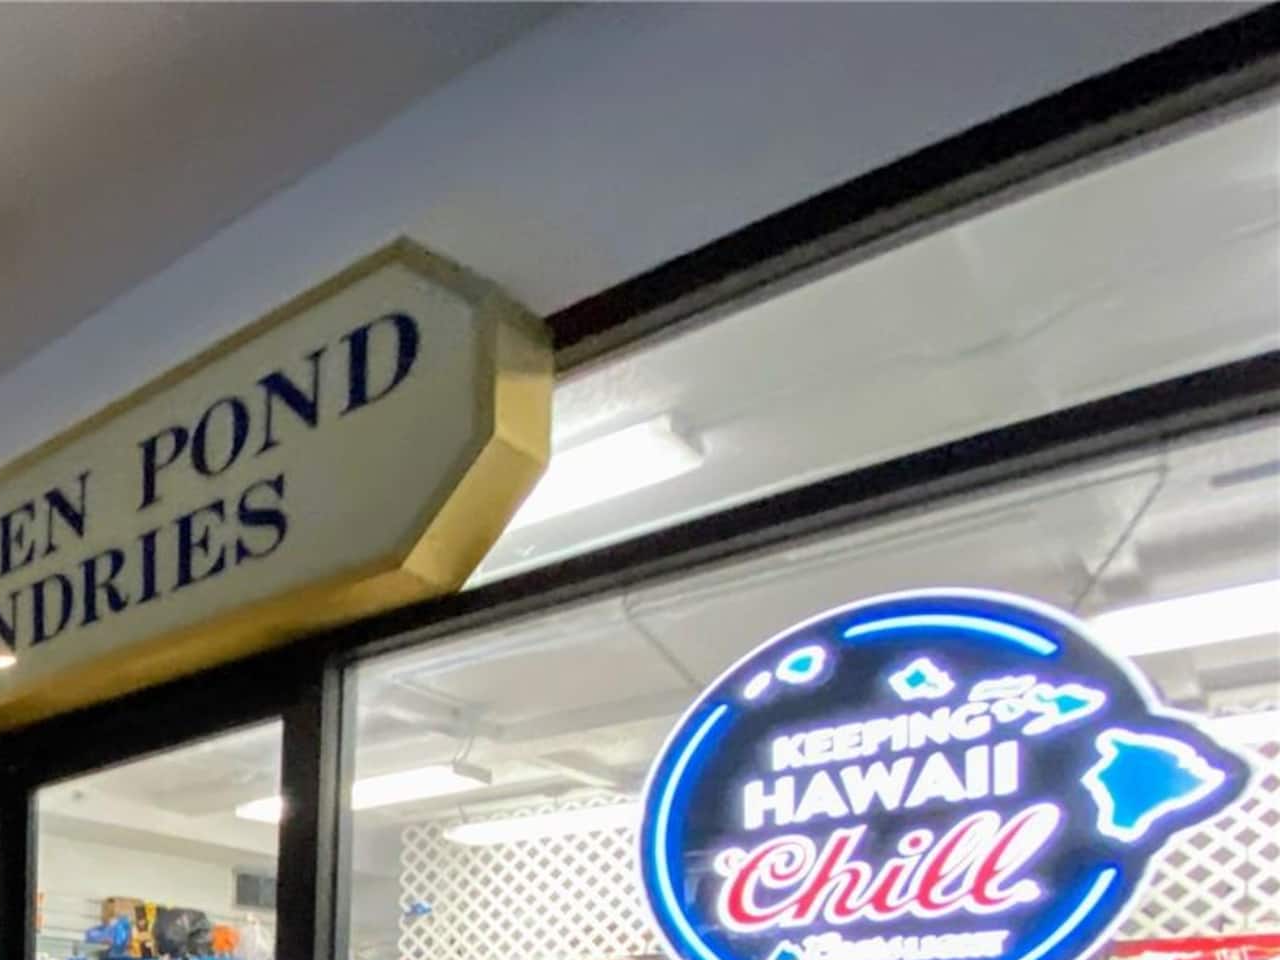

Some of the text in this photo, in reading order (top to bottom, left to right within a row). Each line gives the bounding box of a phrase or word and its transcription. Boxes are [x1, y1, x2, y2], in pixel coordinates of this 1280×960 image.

[135, 312, 420, 512] POND
[743, 741, 1019, 830] HAWAII
[773, 702, 991, 771] KEEPING
[715, 803, 1061, 931] Chill
